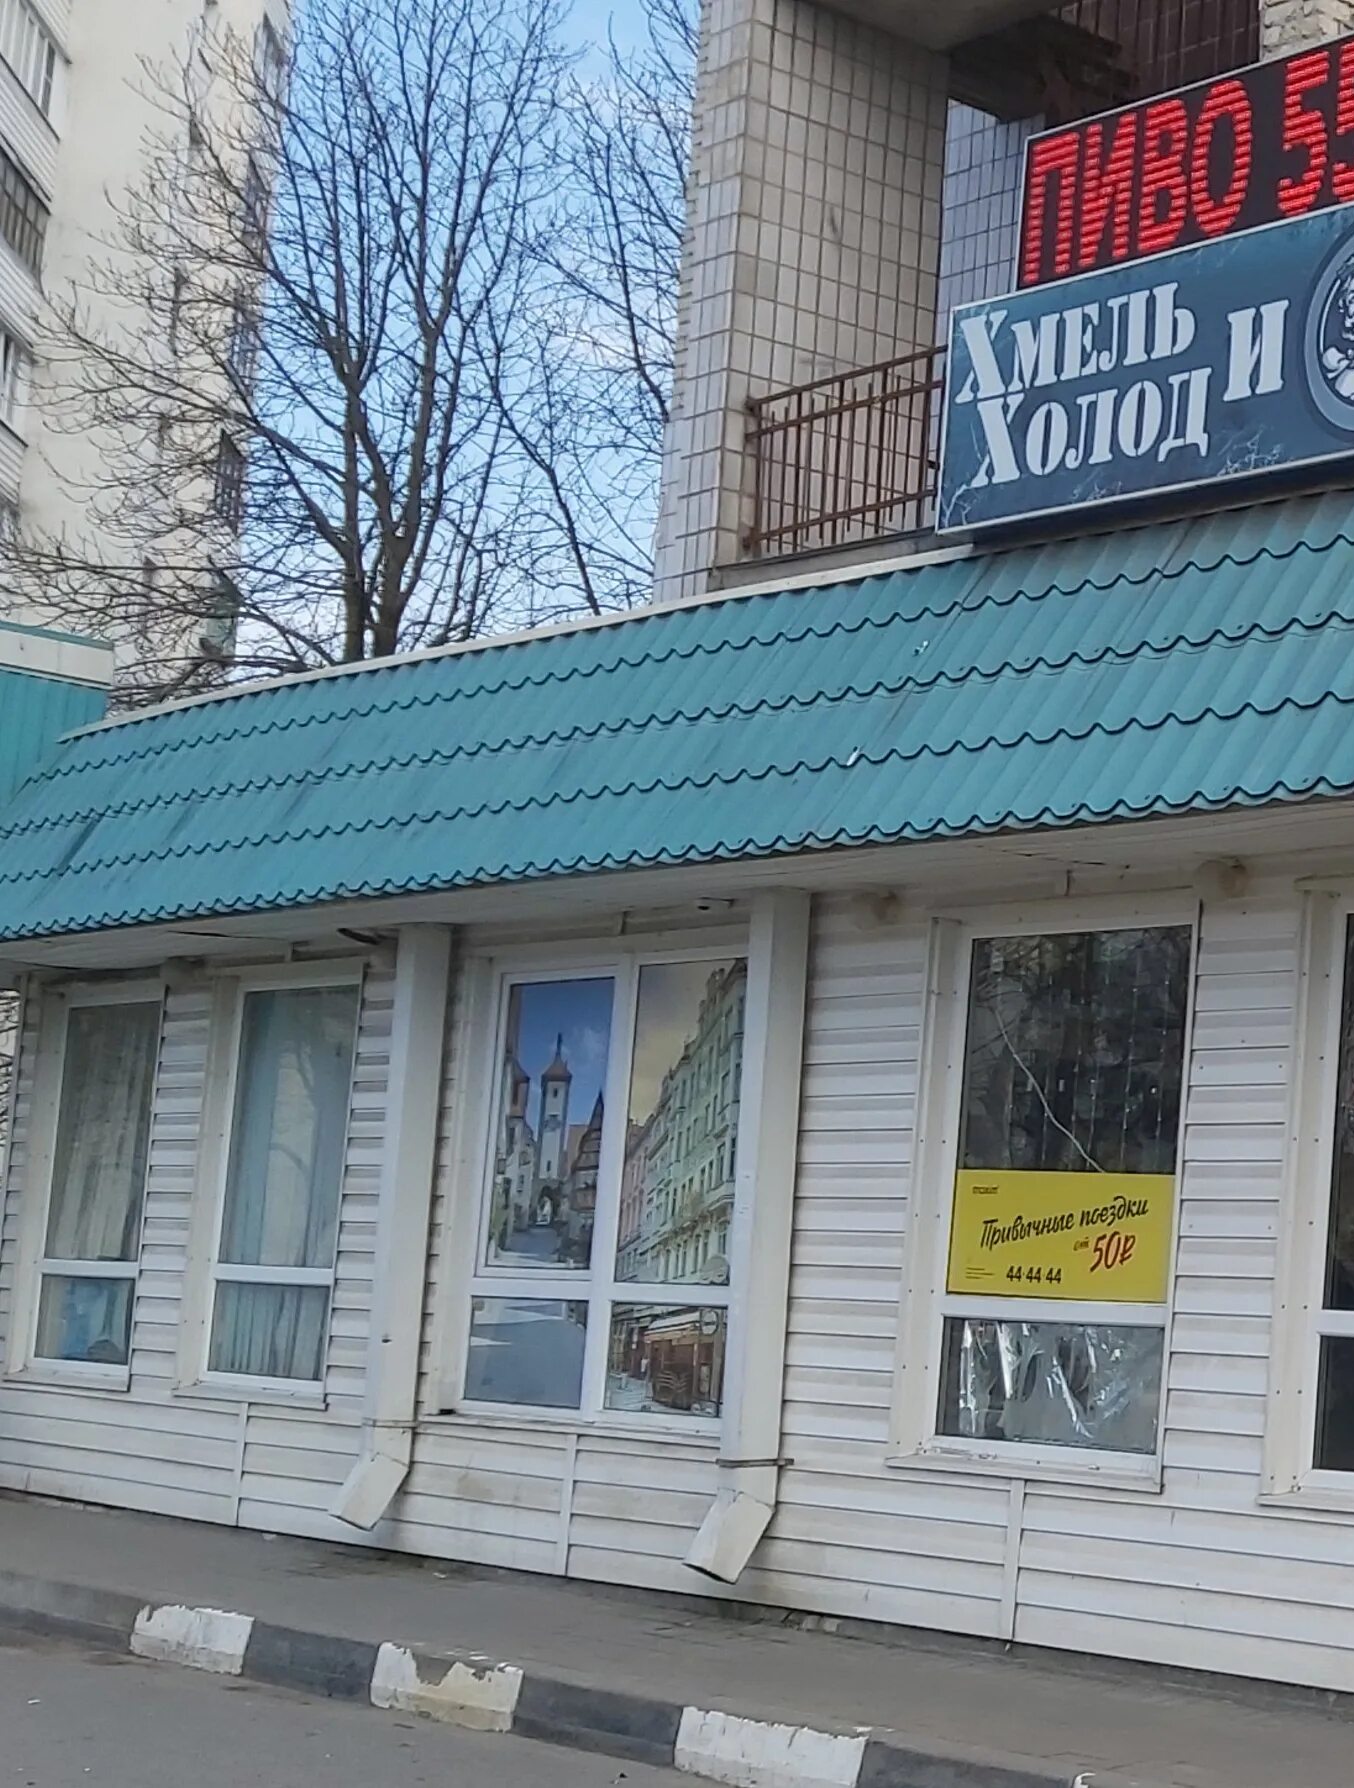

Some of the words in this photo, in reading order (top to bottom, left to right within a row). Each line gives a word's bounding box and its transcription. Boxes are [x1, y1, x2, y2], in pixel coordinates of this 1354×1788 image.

[1023, 80, 1253, 286] ПИВО
[1223, 299, 1290, 402] И
[980, 1214, 1075, 1251] Привычные
[1079, 1196, 1149, 1227] поездки
